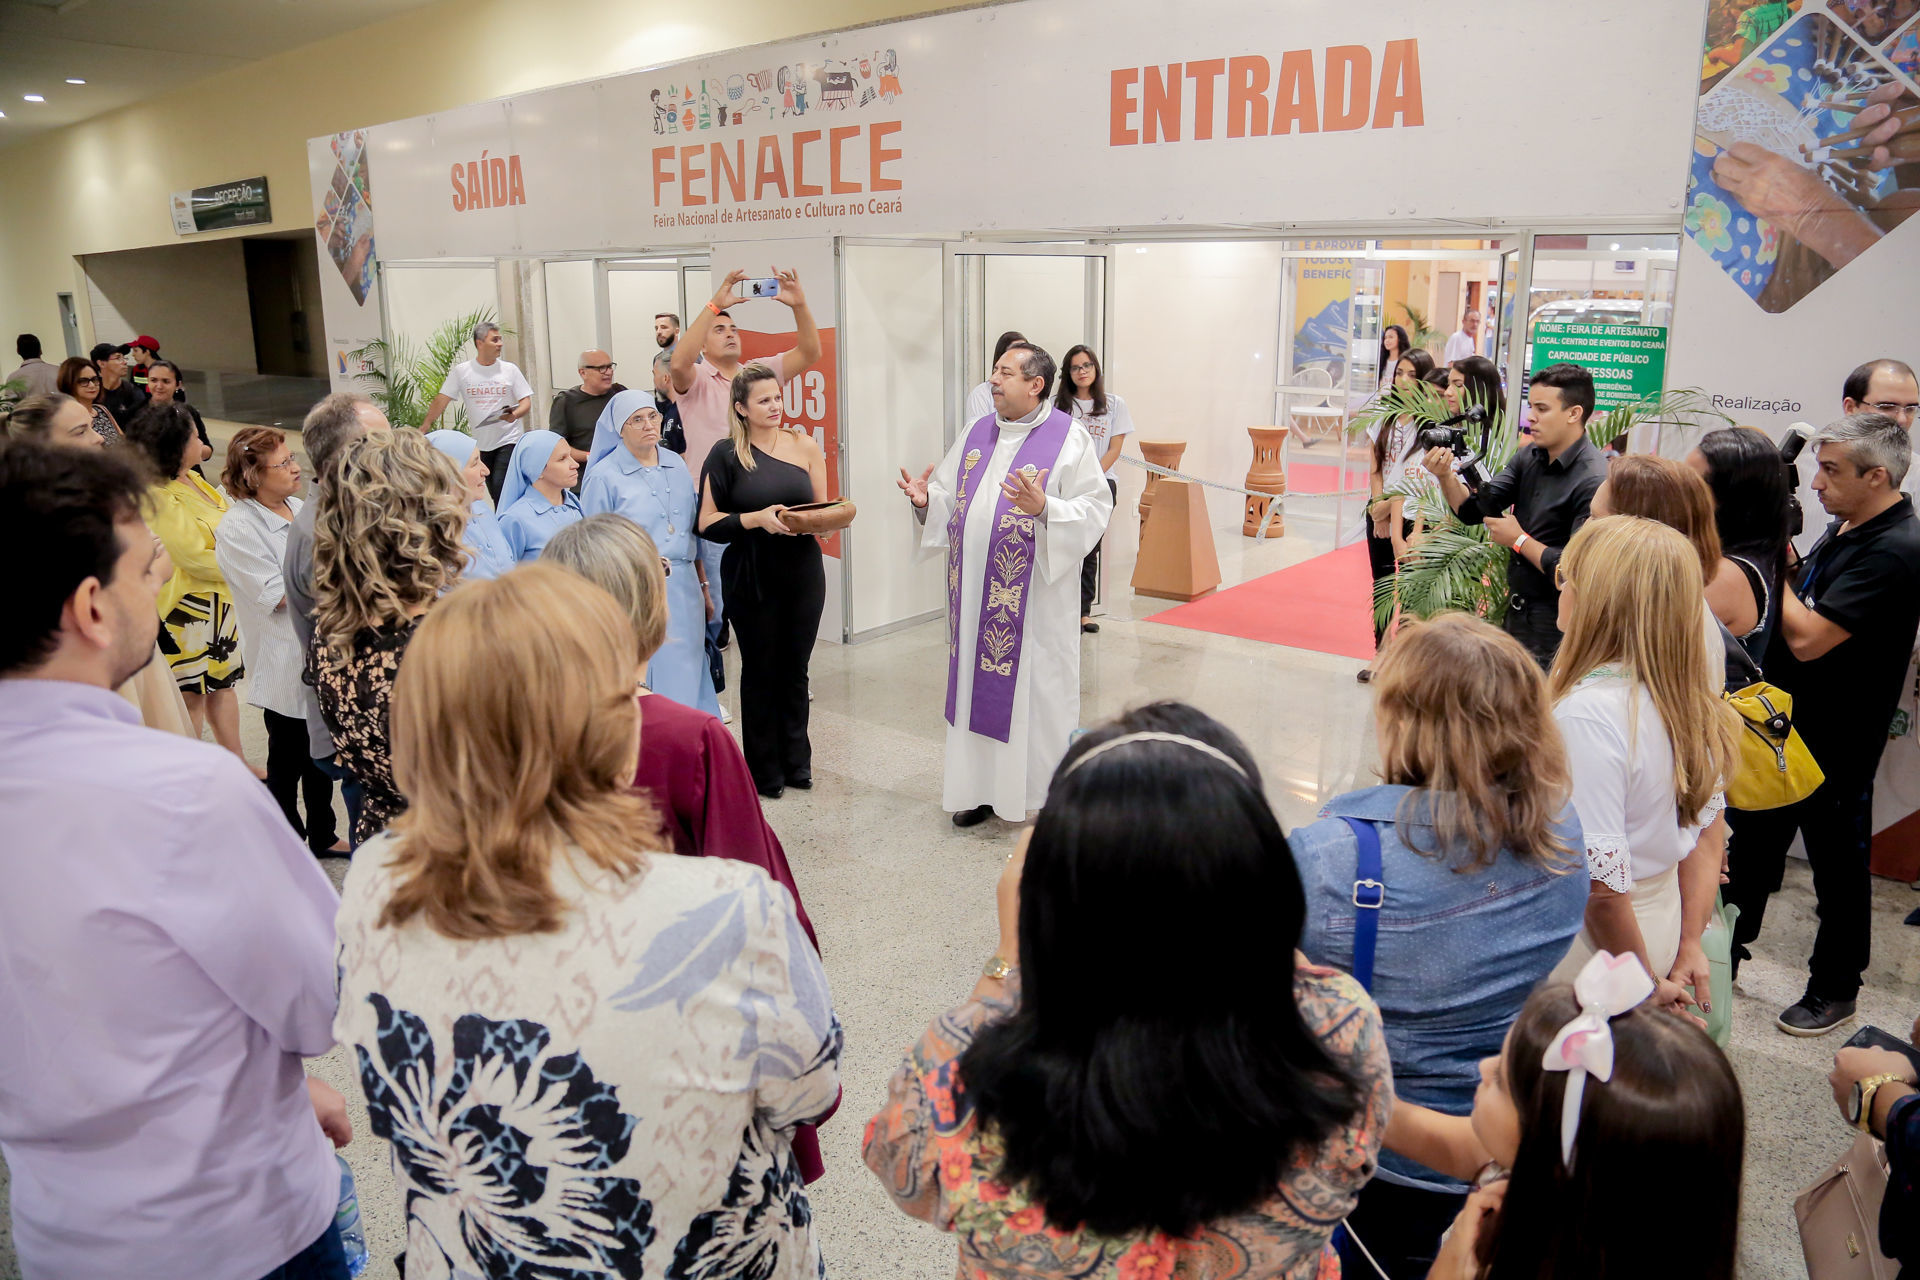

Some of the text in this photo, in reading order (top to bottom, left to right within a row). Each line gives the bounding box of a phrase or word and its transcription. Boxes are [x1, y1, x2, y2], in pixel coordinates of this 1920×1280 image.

[1110, 38, 1424, 146] ENTRADA
[652, 121, 902, 207] FENACCE
[451, 150, 526, 212] SAÍDA
[653, 196, 903, 228] Feira Nacional de Artesanato e Cultura no Ceará
[1315, 240, 1383, 250] APROVEE
[1303, 268, 1352, 279] BENEFÍC
[1539, 323, 1660, 338] NOME: FEIRA DE ARTESANATO
[1536, 337, 1665, 350] LOCAL: CENTRO DE EVENTOS DO CEARÁ
[1548, 350, 1650, 365] CAPACIDADE DE PÚBLICO
[1587, 368, 1633, 380] PESSOAS
[1712, 394, 1802, 415] Realização
